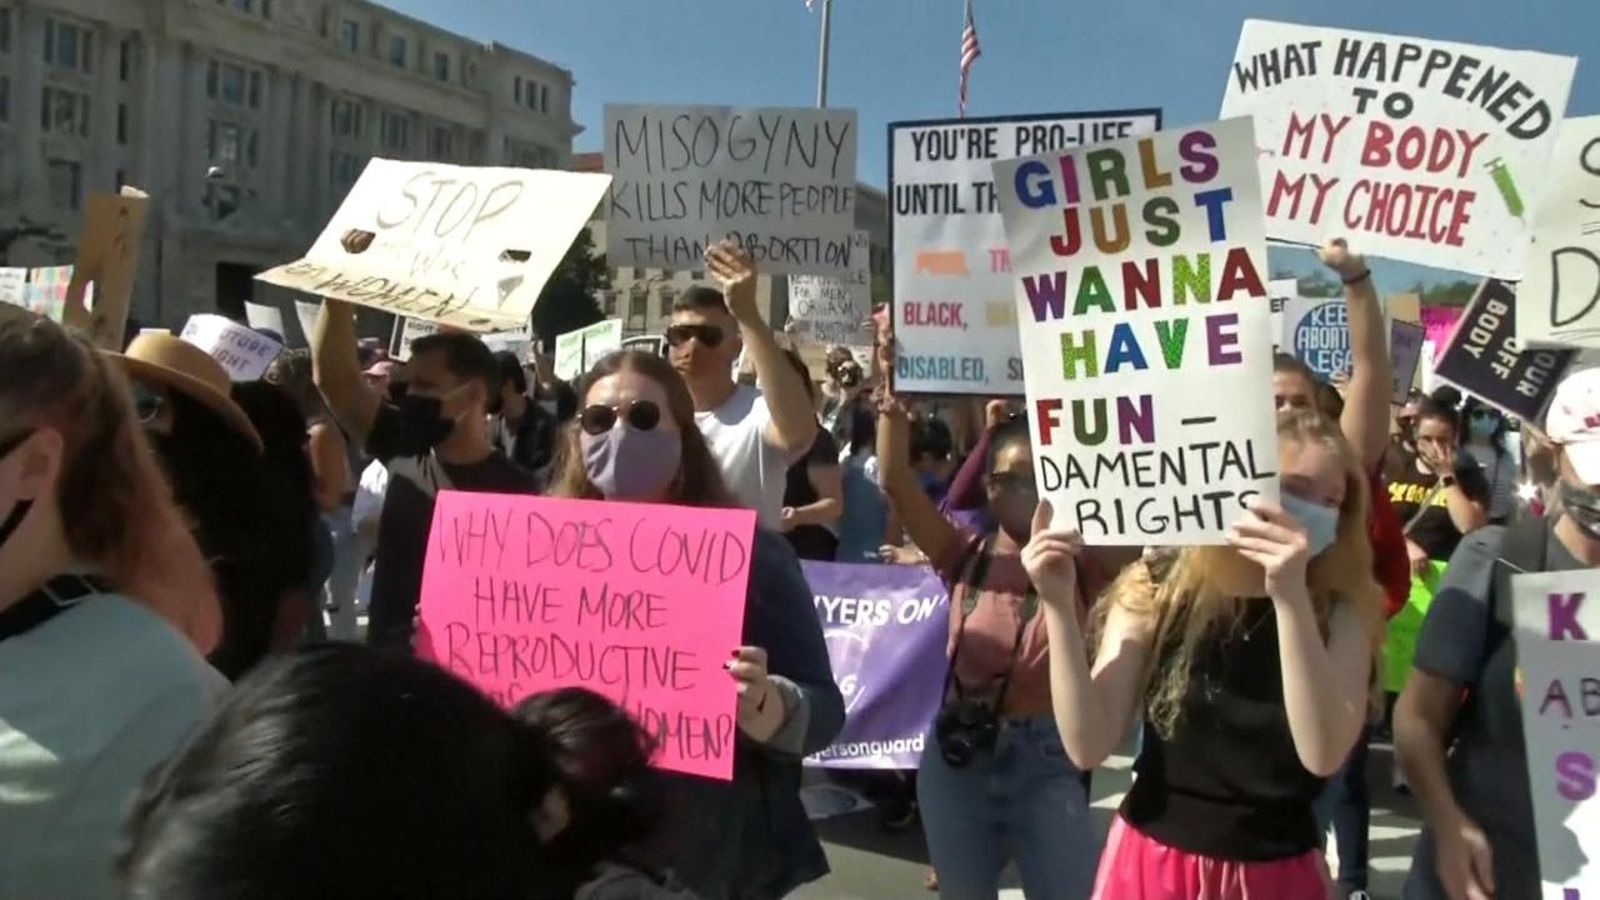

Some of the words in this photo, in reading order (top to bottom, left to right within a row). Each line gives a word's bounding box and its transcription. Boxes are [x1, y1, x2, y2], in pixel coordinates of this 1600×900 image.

[1233, 40, 1323, 93] WHAT
[1332, 38, 1551, 140] HAPPENED
[1352, 86, 1414, 119] TO
[614, 114, 850, 180] MISOGYNY
[910, 127, 999, 162] YOU'RE
[1014, 130, 1219, 209] GIRLS
[1282, 111, 1352, 163] MY
[1360, 120, 1490, 178] BODY
[376, 170, 524, 242] STOP
[610, 180, 688, 222] KILLS
[699, 178, 774, 220] MORE
[779, 182, 853, 220] PEOPLE
[895, 182, 966, 216] UNTIL
[1049, 187, 1233, 256] JUST
[1266, 169, 1340, 225] MY
[1343, 178, 1477, 247] CHOICE
[624, 233, 710, 265] THAN
[314, 272, 480, 318] WOMEN
[1021, 247, 1267, 322] WANNA
[903, 302, 968, 330] BLACK,
[1462, 299, 1509, 359] BODY
[898, 355, 989, 385] DISABLED,
[1060, 313, 1242, 380] HAVE
[1036, 394, 1156, 446] FUN
[1040, 439, 1277, 491] DAMENTAL
[438, 504, 513, 569] WHY
[526, 511, 613, 574] DOES
[629, 517, 746, 586] COVID
[473, 576, 563, 626] HAVE
[577, 581, 668, 633] MORE
[813, 594, 889, 627] YERS
[444, 621, 700, 706] REPRODUCTIVE
